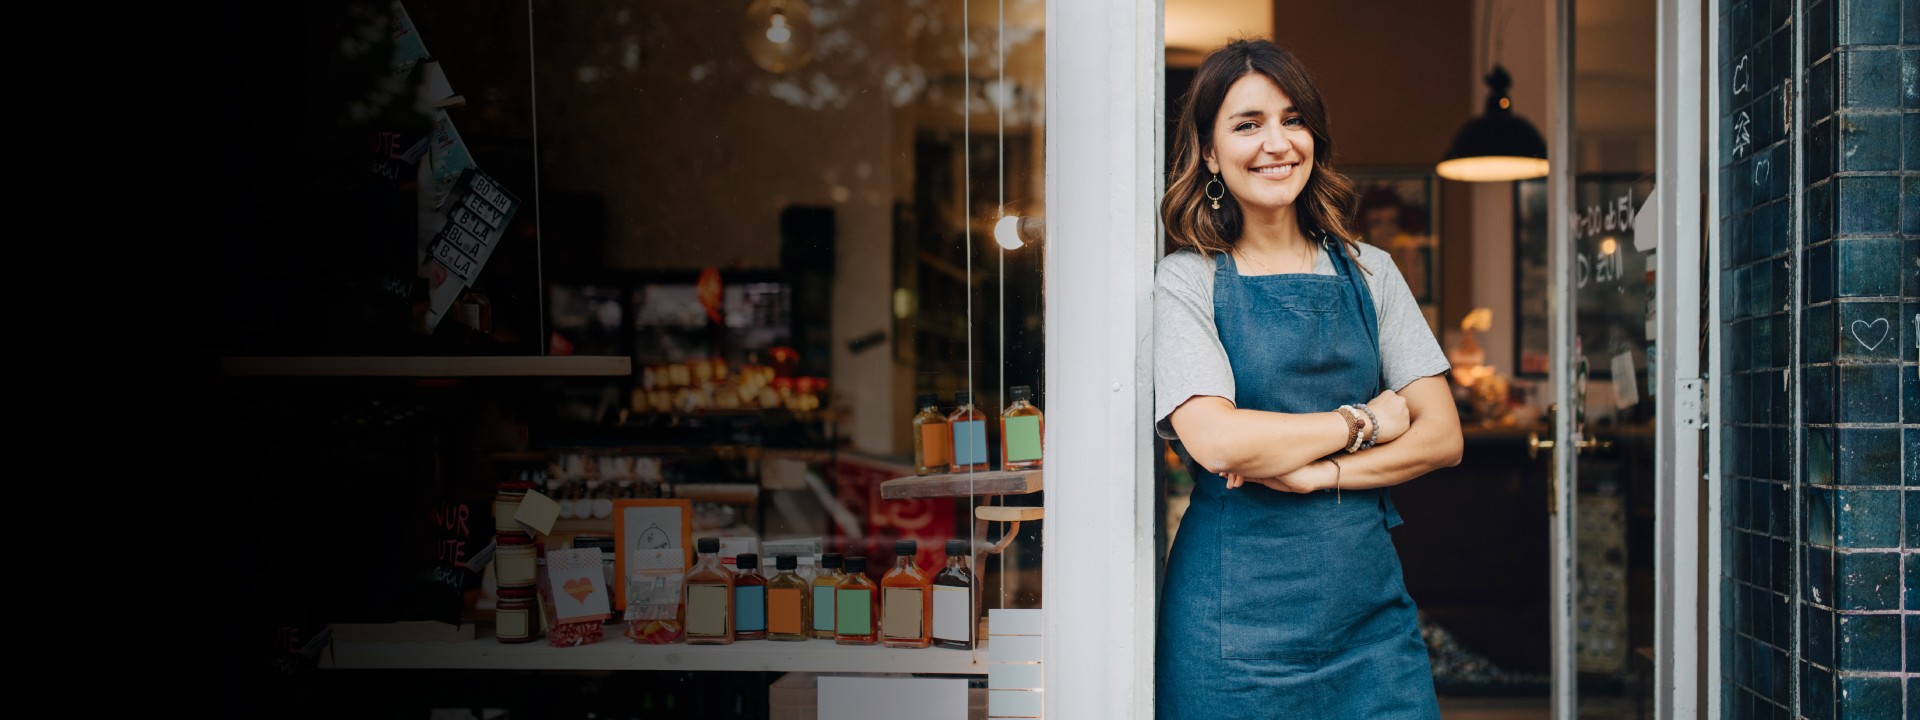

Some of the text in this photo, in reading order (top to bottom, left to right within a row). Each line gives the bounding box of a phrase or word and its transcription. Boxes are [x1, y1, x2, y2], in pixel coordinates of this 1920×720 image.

[470, 196, 486, 214] EE
[472, 222, 490, 241] LA
[449, 227, 480, 258] BL A
[453, 255, 471, 275] LA
